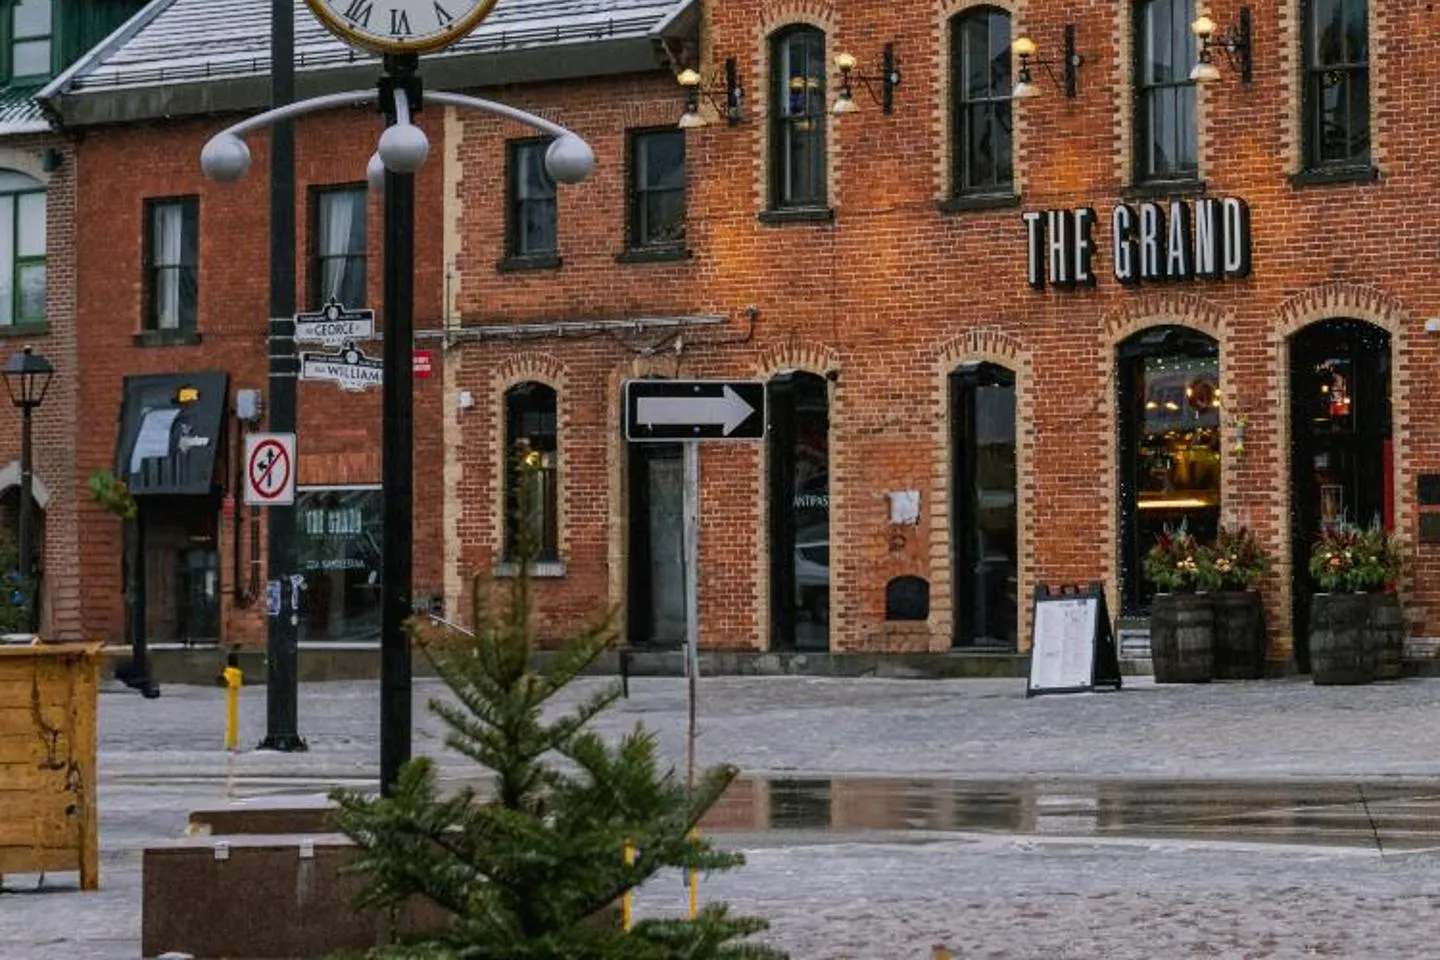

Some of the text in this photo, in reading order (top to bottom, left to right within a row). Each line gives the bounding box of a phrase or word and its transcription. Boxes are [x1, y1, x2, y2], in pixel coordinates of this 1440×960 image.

[390, 9, 413, 35] VI
[433, 0, 453, 26] V
[1022, 196, 1246, 286] THE GRAND
[314, 322, 354, 337] GEORGE
[327, 364, 379, 381] WILLIAM
